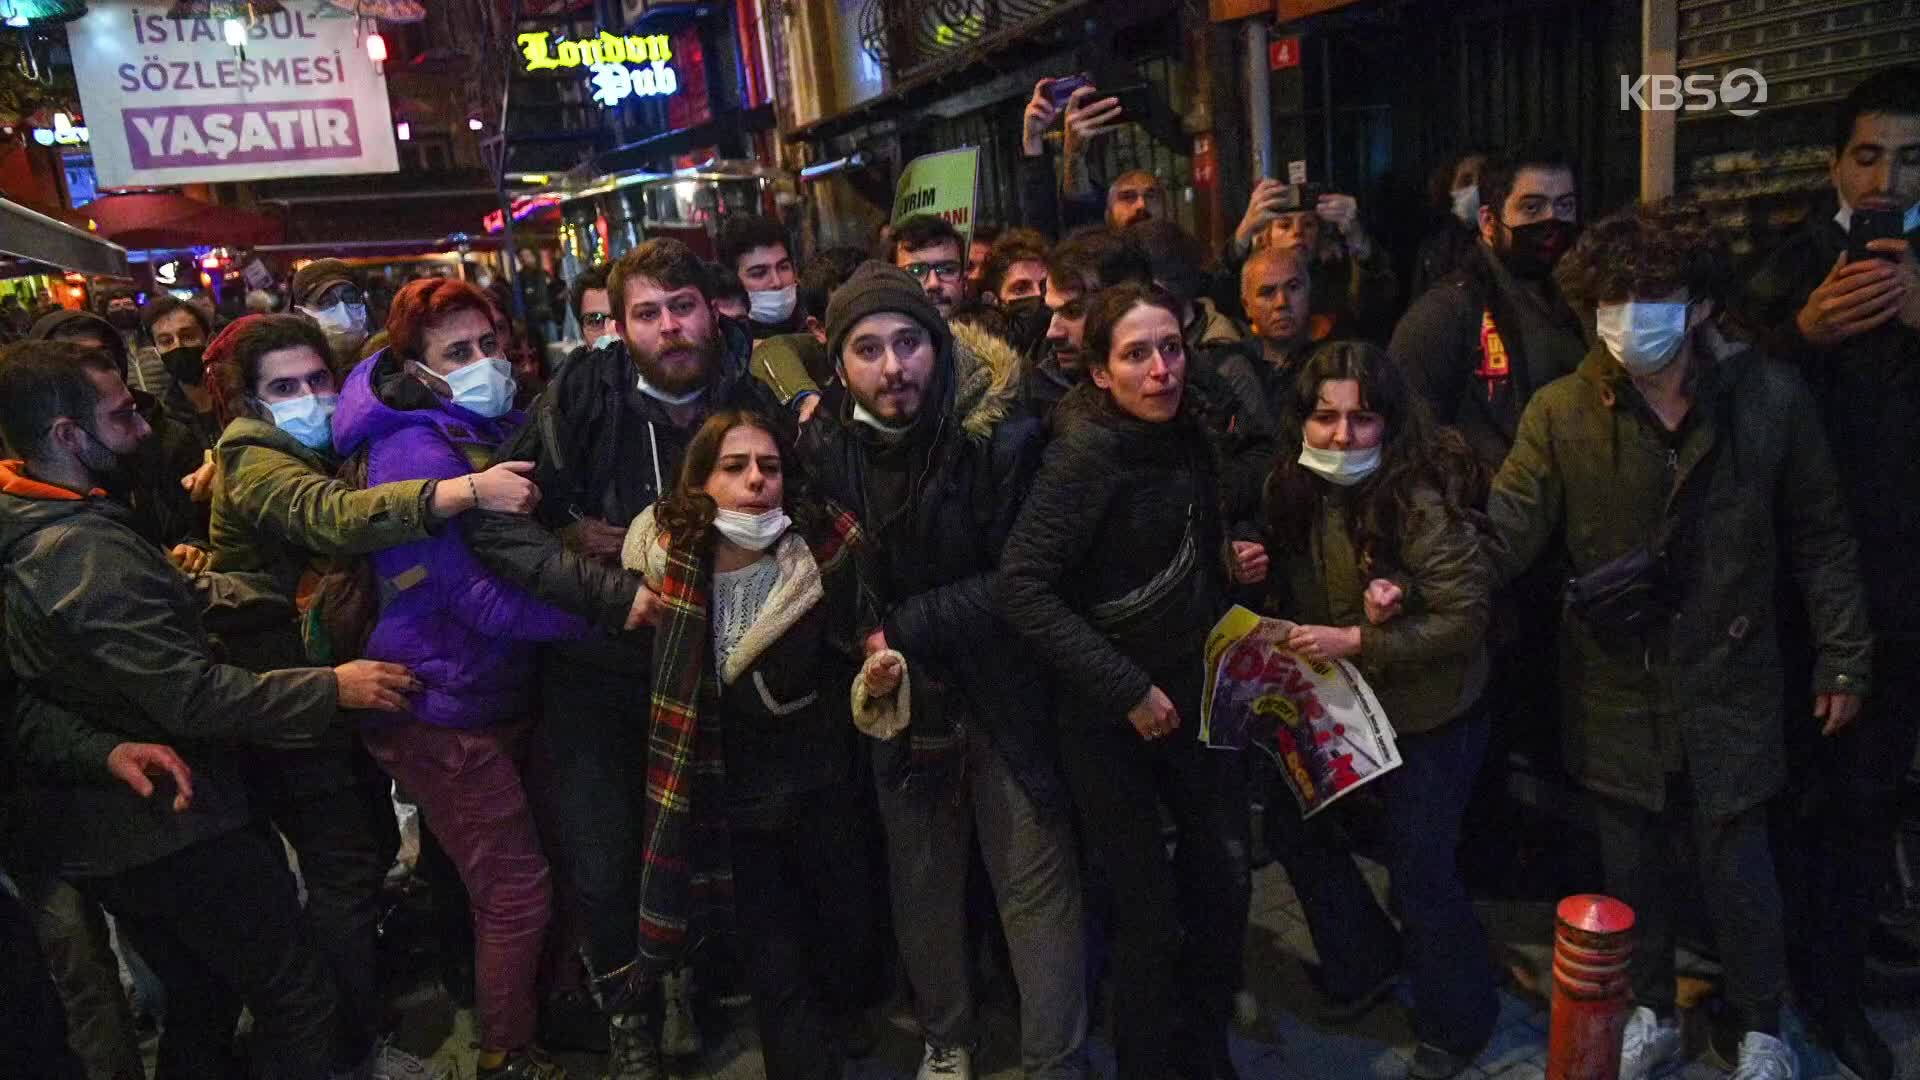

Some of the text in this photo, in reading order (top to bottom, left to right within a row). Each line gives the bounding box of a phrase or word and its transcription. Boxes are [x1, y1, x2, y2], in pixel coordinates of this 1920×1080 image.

[132, 8, 316, 44] İSTABUL
[118, 50, 345, 92] SÖZLEŞMESİ
[517, 31, 672, 72] London
[1277, 43, 1290, 64] 4
[590, 60, 677, 106] Pub
[132, 108, 353, 160] YAŞATIR
[935, 206, 968, 225] ANI
